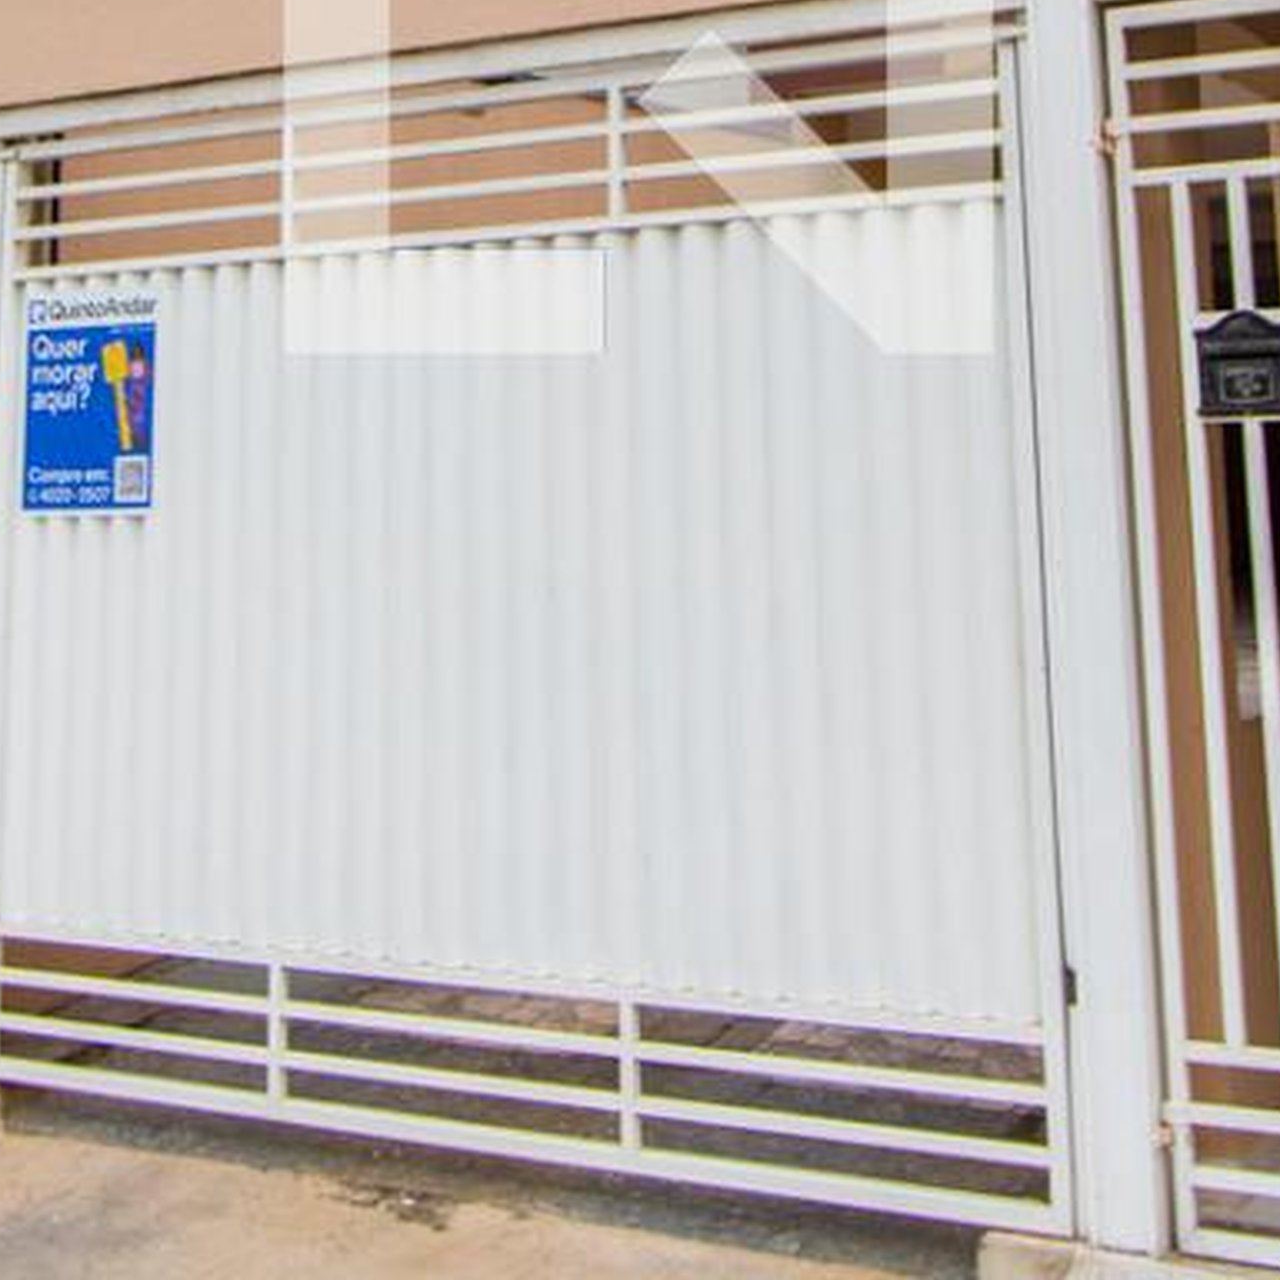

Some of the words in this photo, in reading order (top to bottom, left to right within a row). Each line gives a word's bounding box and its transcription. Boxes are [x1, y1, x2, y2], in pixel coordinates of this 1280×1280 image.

[49, 297, 157, 320] QuintoAndar
[31, 333, 89, 361] Quer
[31, 361, 98, 386] morar
[30, 383, 91, 416] aqui?
